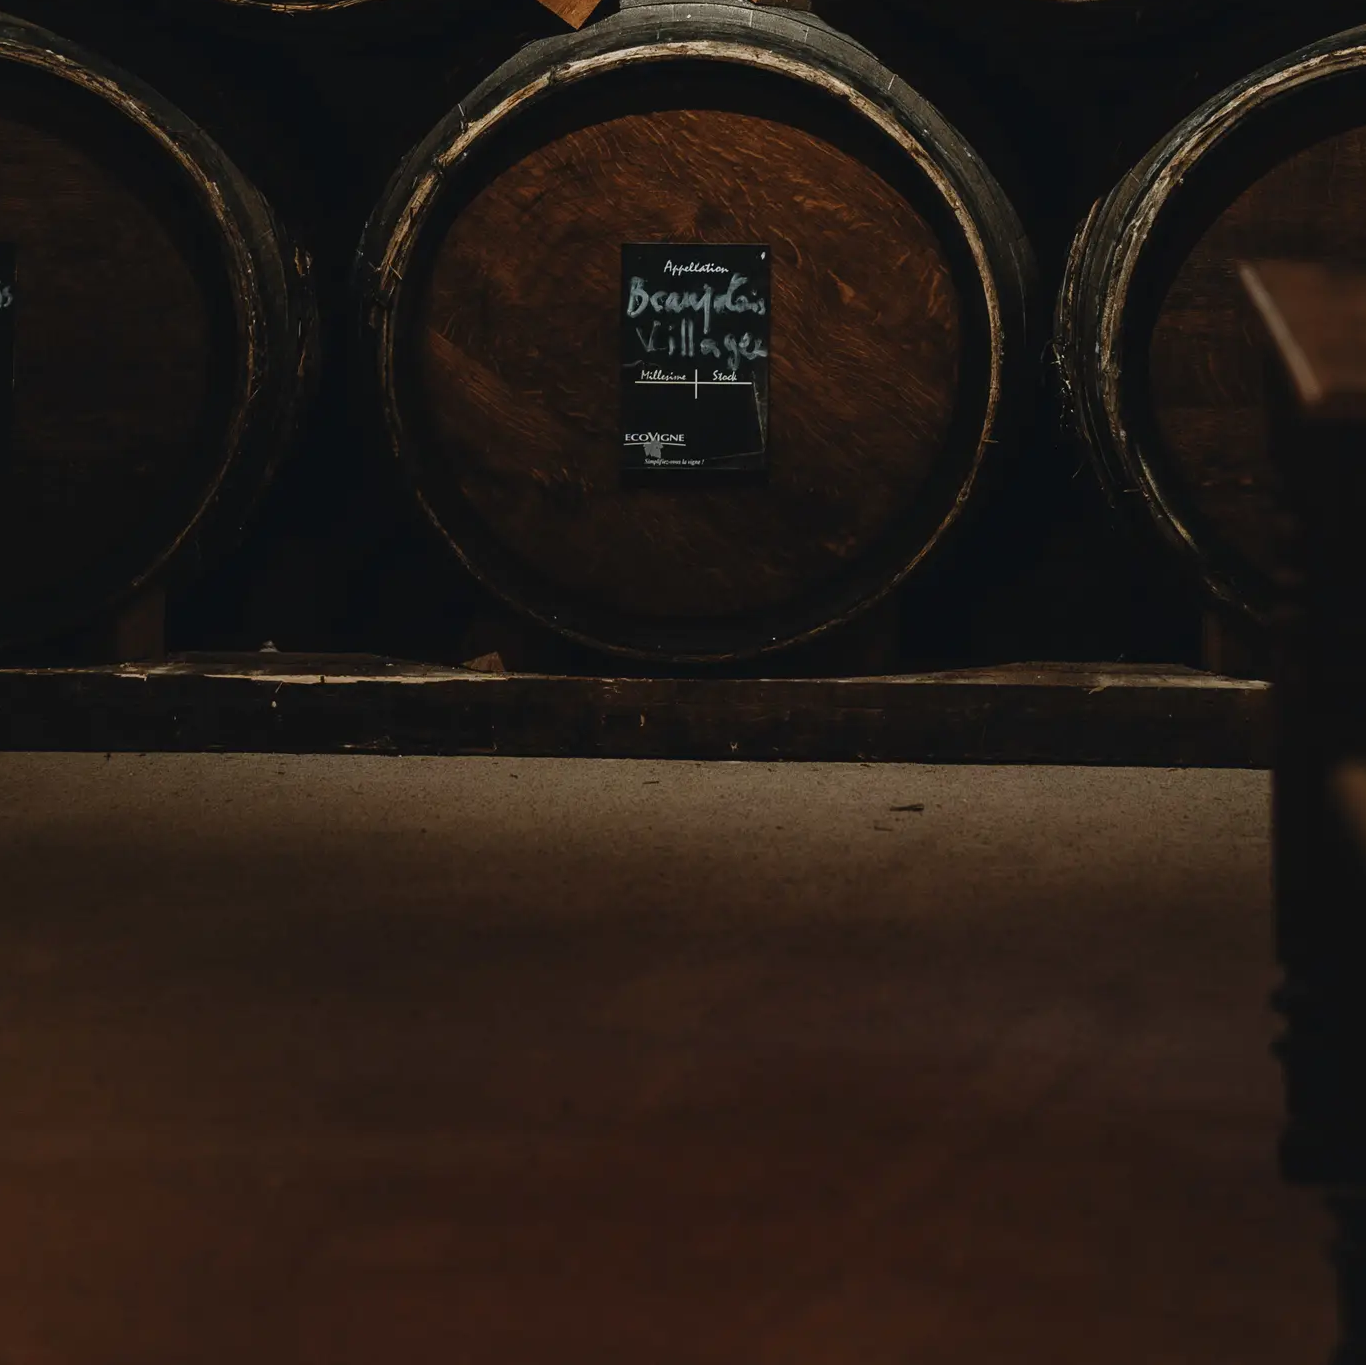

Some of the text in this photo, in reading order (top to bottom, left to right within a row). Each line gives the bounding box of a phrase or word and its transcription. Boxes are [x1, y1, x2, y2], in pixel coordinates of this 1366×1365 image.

[663, 259, 729, 276] Appellation
[712, 370, 737, 381] Stock
[625, 432, 685, 442] ECOVIGNE
